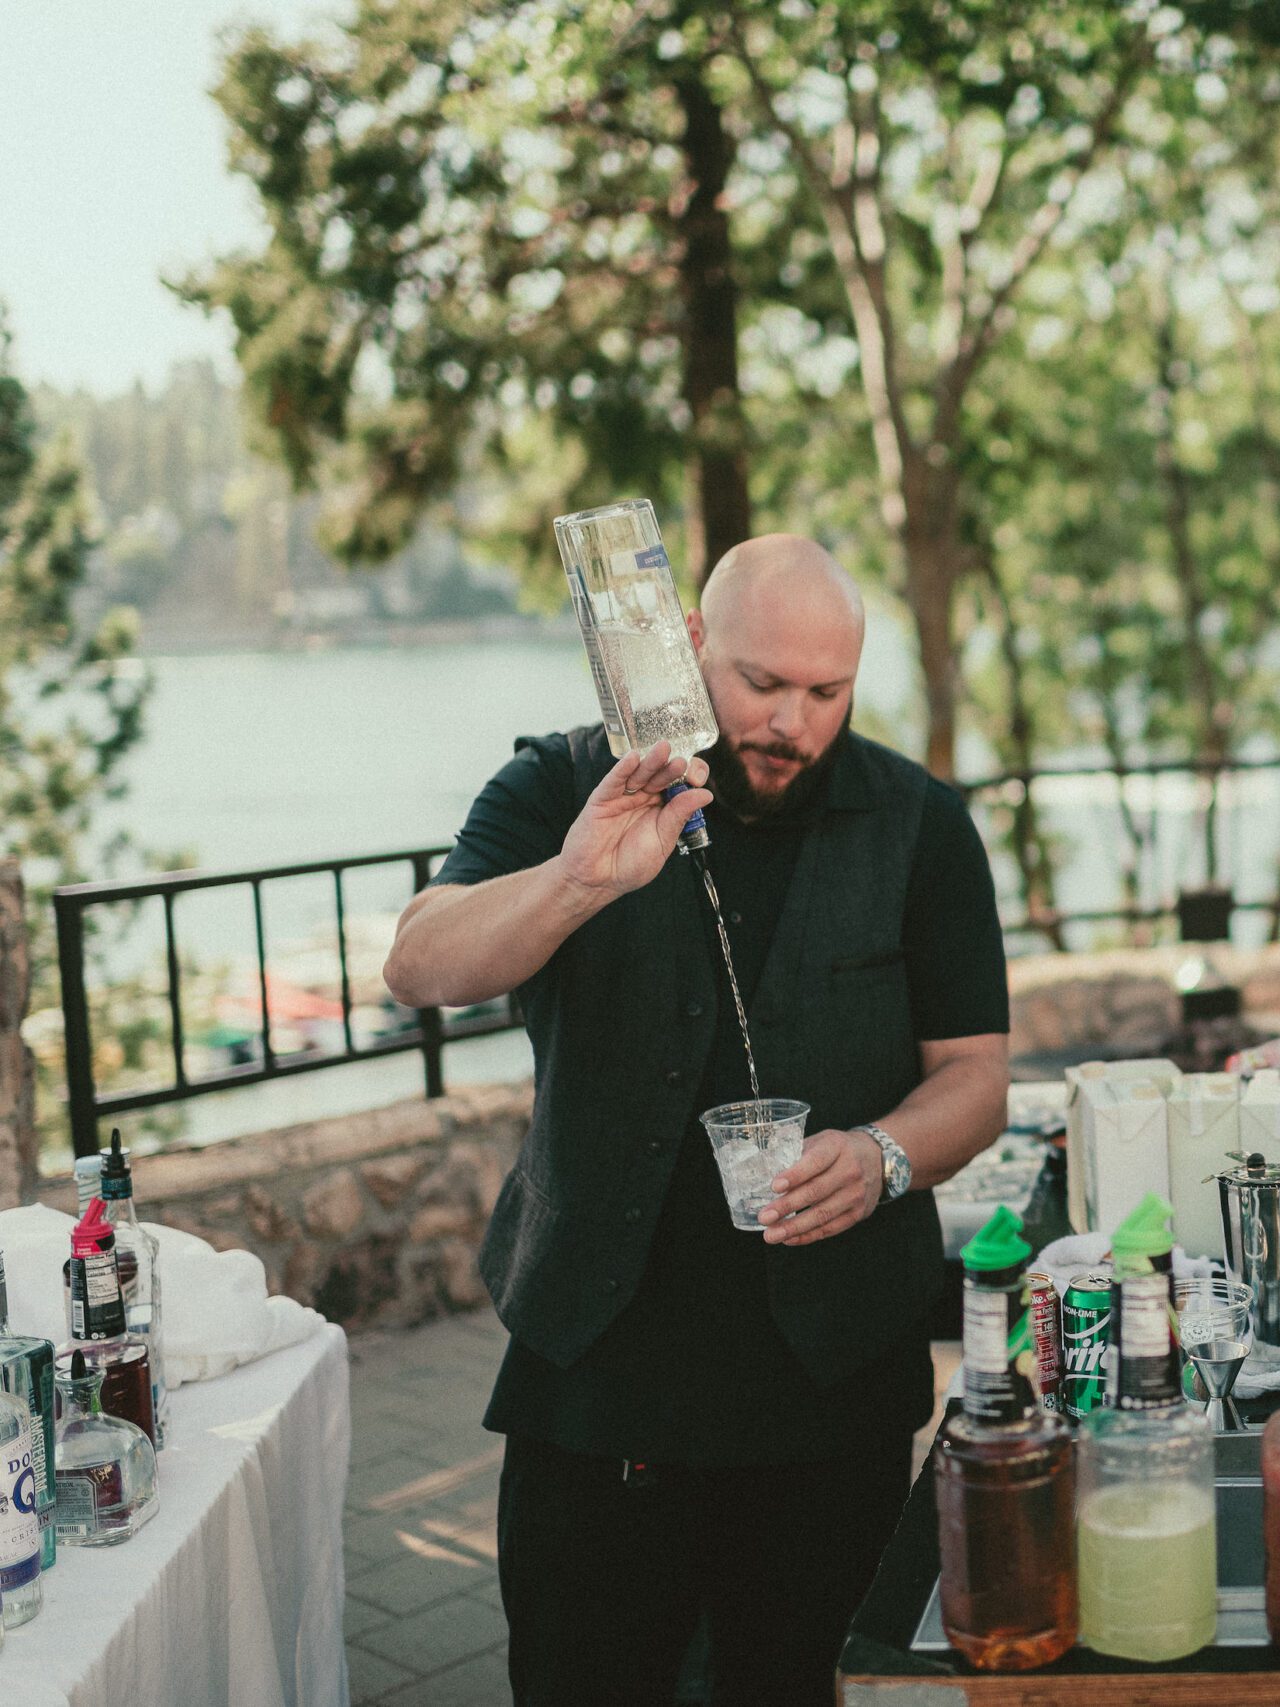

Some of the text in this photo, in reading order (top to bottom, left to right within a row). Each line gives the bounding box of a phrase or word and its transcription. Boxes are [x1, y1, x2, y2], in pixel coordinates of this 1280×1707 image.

[1063, 1305, 1098, 1318] MON-LIME
[1064, 1338, 1110, 1371] rit
[31, 1415, 48, 1493] AMSTERDAM
[13, 1466, 37, 1514] Q
